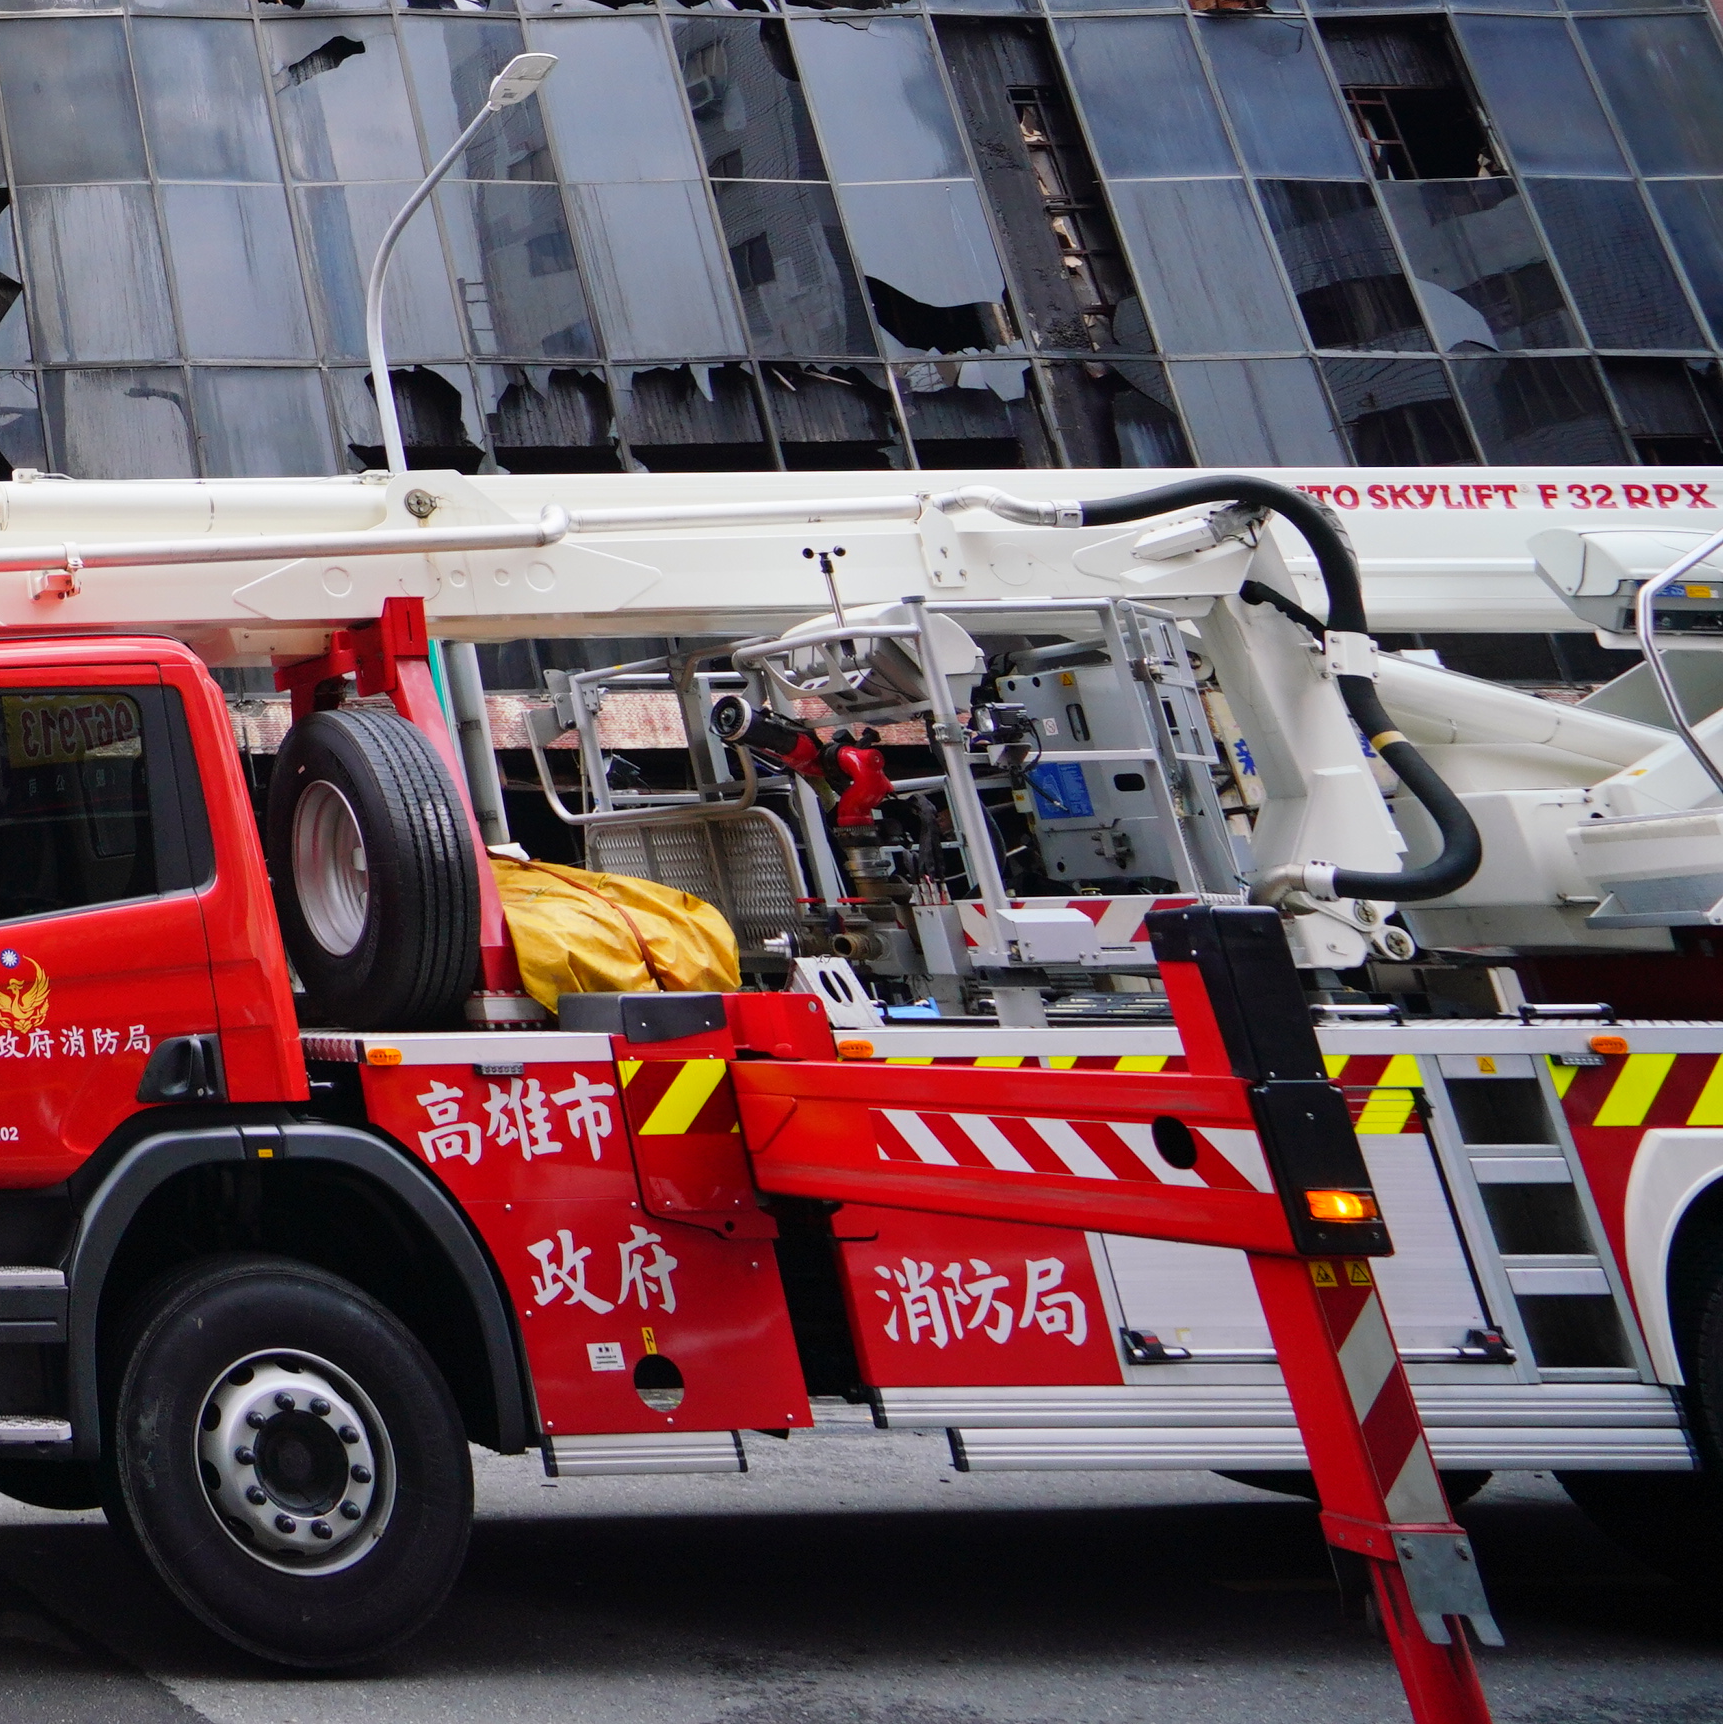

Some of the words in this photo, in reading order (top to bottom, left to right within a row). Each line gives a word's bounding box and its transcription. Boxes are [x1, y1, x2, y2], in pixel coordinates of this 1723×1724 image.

[1296, 484, 1359, 510] TO
[1538, 484, 1557, 509] F
[417, 1071, 615, 1165] 高雄市
[527, 1224, 678, 1315] 政府
[875, 1257, 1087, 1350] 消防局
